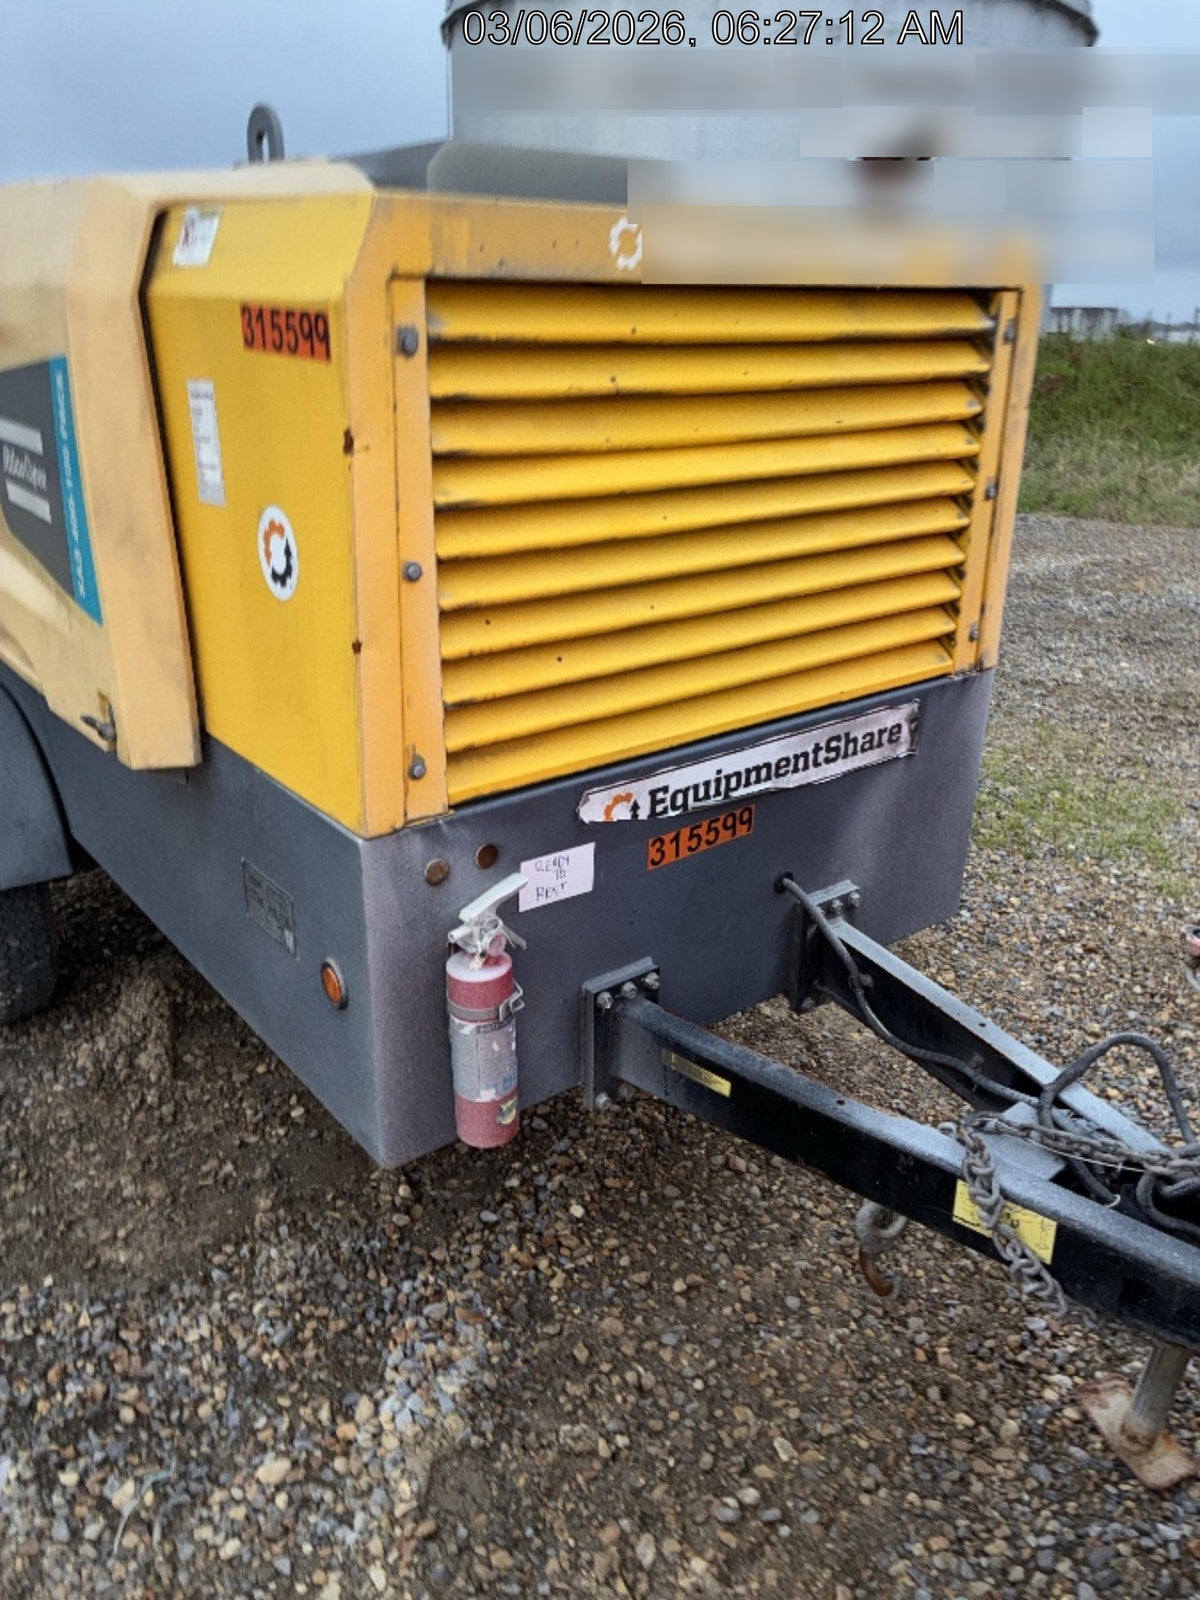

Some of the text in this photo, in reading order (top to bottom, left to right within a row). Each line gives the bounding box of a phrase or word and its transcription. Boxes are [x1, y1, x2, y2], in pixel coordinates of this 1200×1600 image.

[240, 305, 332, 361] 315599
[648, 722, 903, 820] EquipmentShare
[649, 807, 755, 868] 315599
